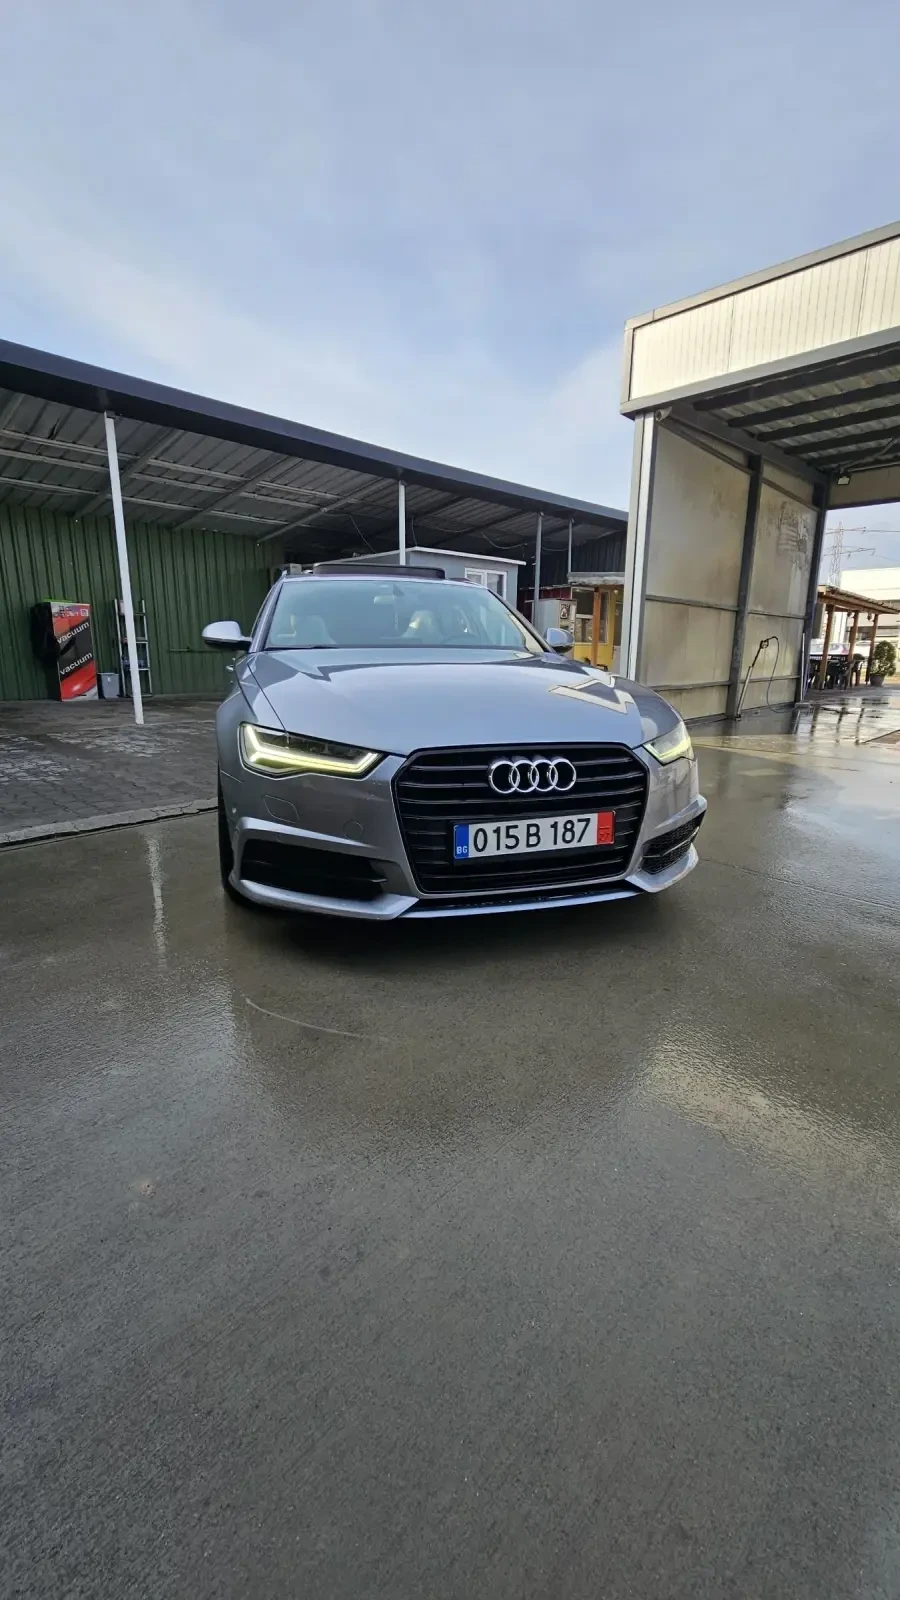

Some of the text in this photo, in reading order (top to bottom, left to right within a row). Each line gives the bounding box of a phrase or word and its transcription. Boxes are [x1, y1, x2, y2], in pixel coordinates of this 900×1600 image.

[57, 621, 90, 644] vacuum
[60, 652, 92, 675] vacuum
[550, 817, 591, 846] 187
[456, 846, 468, 855] BG
